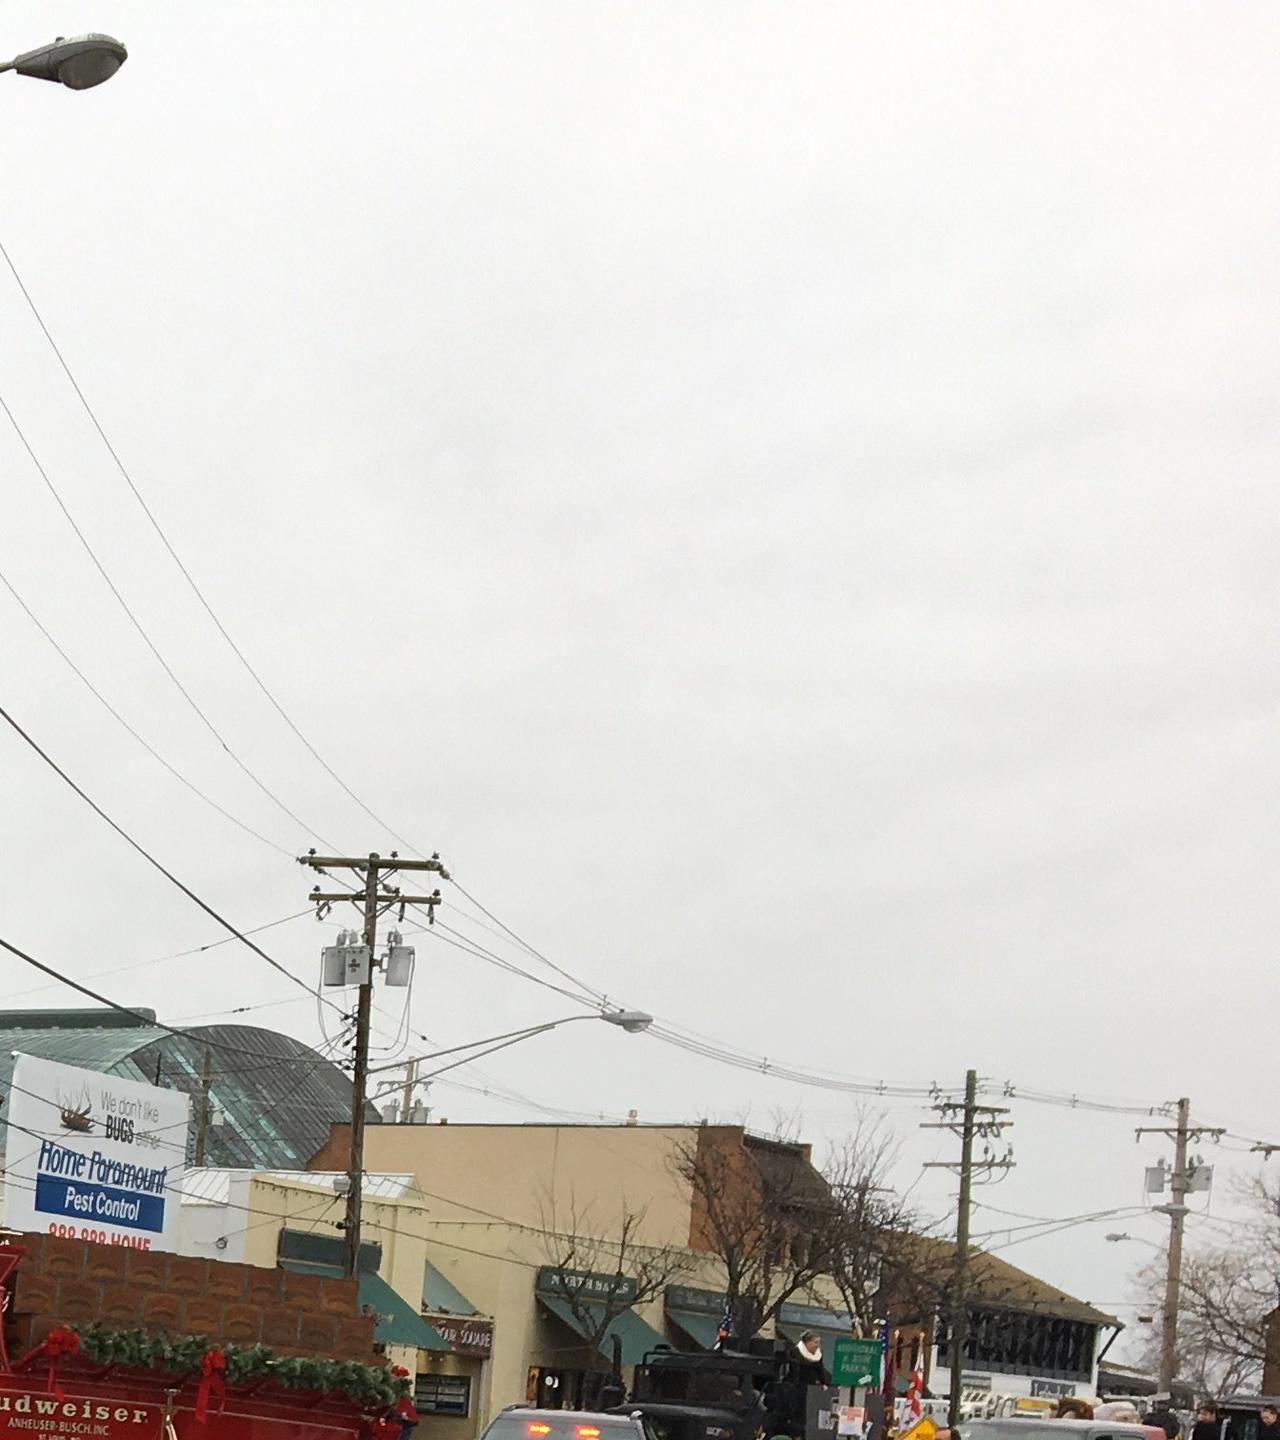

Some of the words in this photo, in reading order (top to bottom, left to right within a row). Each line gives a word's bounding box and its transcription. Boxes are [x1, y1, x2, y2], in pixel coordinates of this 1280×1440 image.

[100, 1091, 117, 1113] We
[142, 1101, 160, 1123] like
[105, 1114, 135, 1145] BUGS
[38, 1139, 87, 1179] Home
[88, 1150, 167, 1195] Paramount
[64, 1186, 93, 1213] Pest
[95, 1191, 141, 1222] Control
